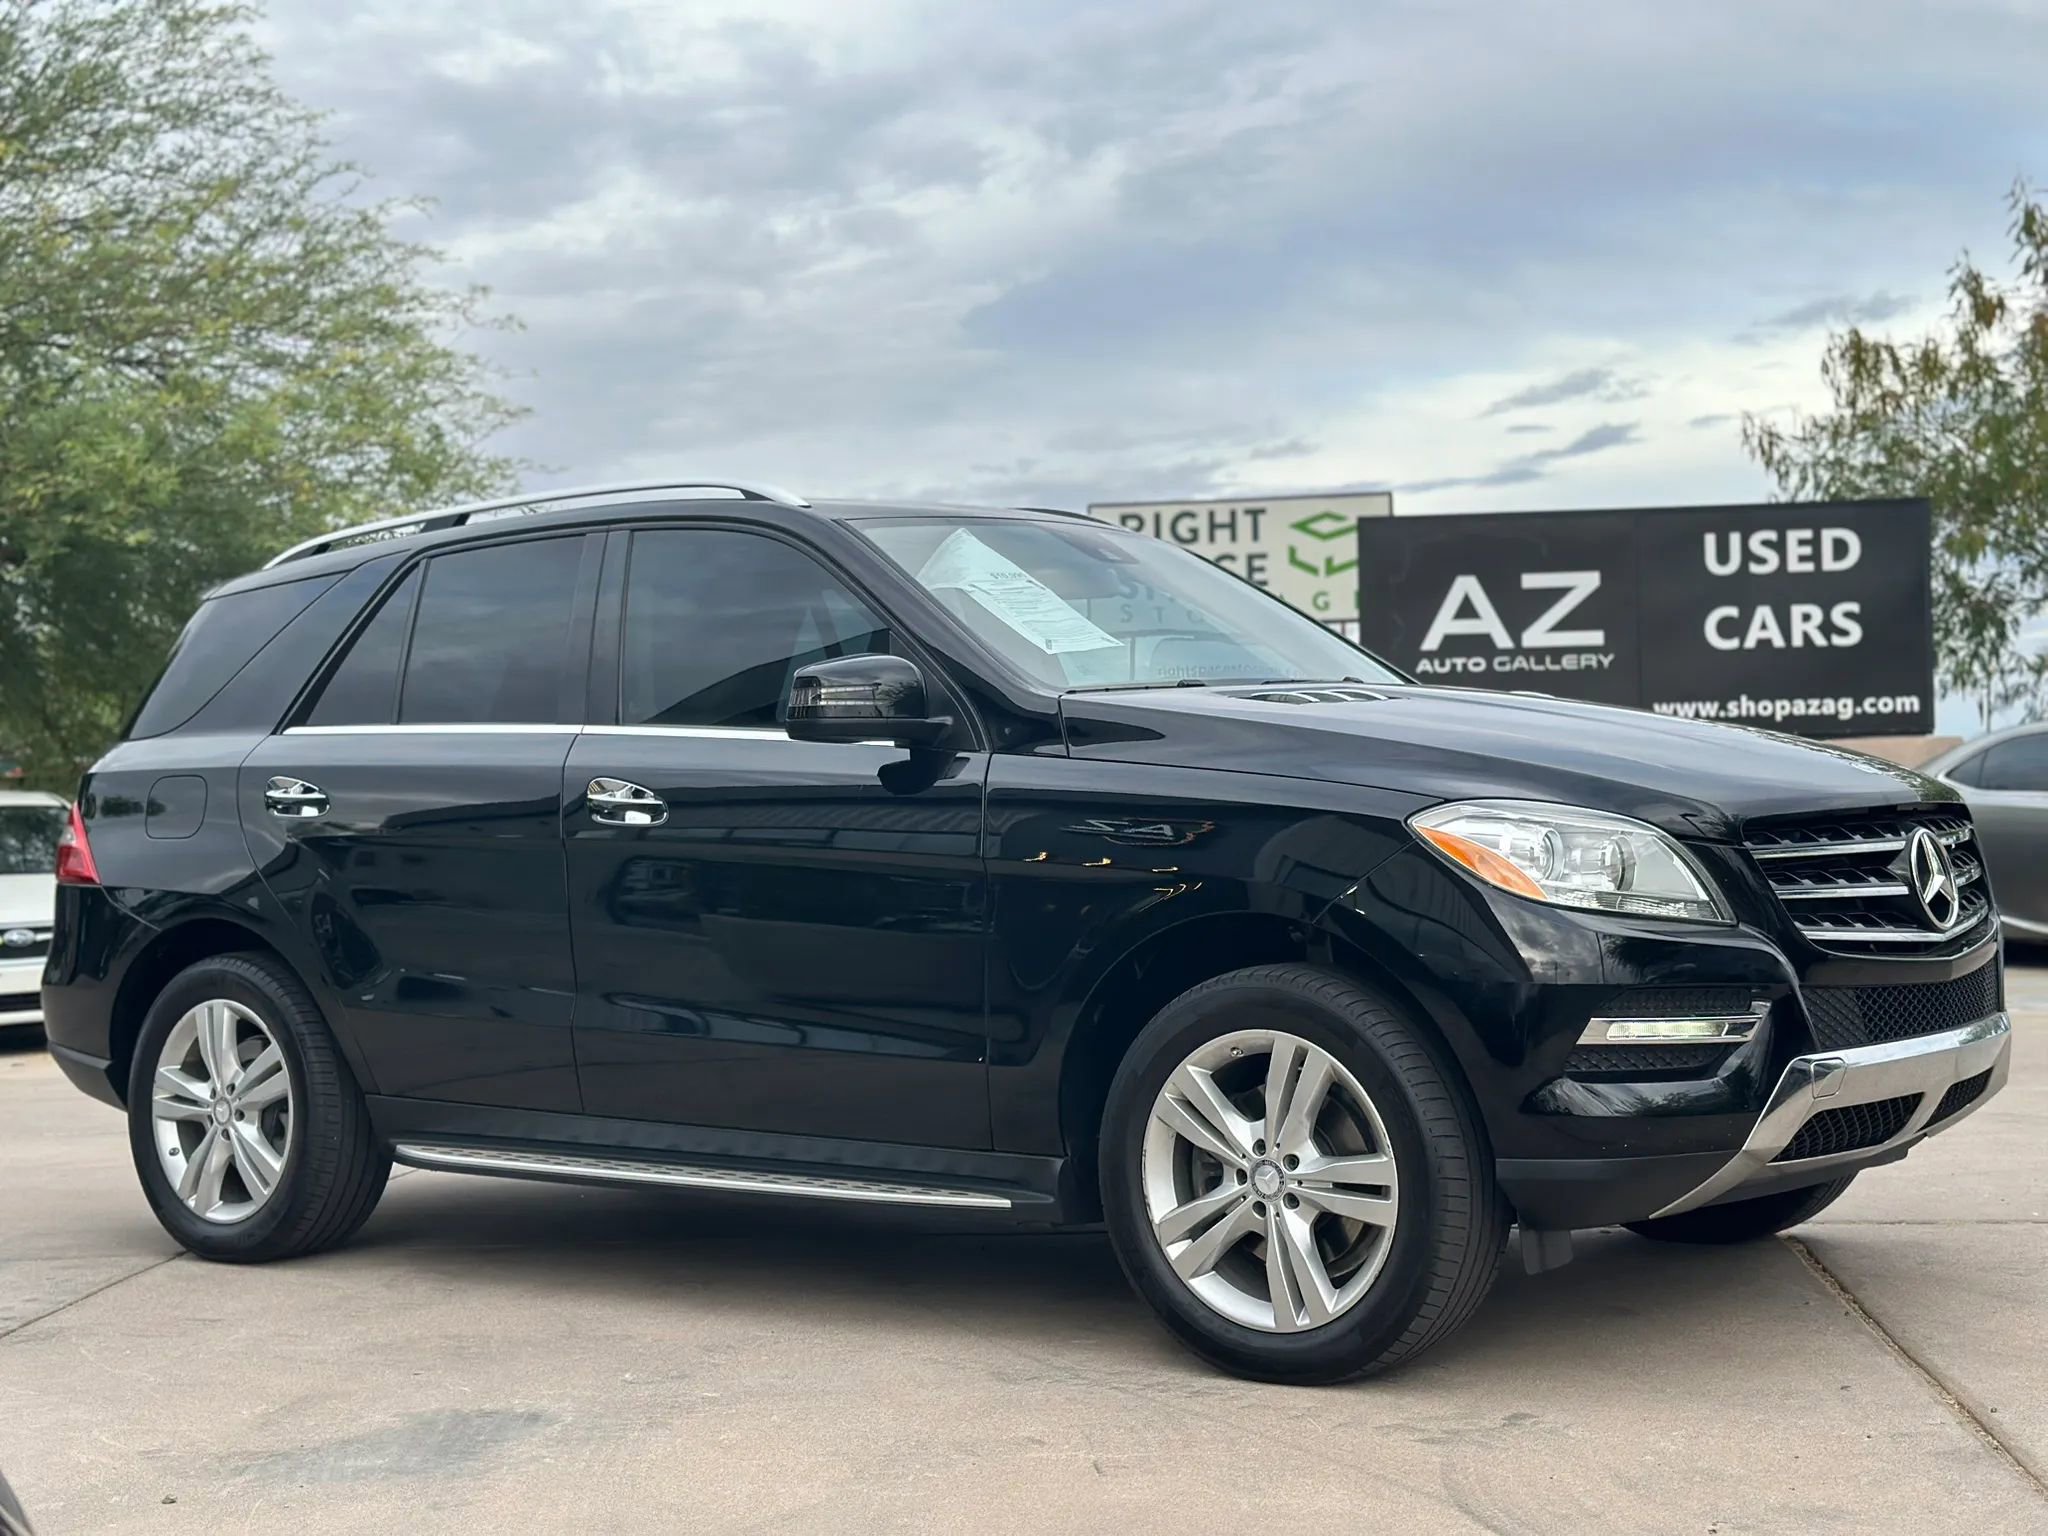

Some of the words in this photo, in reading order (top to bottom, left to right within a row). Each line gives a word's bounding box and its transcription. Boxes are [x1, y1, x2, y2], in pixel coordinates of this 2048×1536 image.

[1119, 508, 1267, 545] RIGHT
[1703, 527, 1862, 576] USED
[1419, 570, 1605, 651] AZ
[1703, 601, 1863, 650] CARS
[1416, 656, 1487, 674] AUTO
[1492, 653, 1615, 672] GALLERY
[1653, 694, 1920, 722] www.shopazag.com
